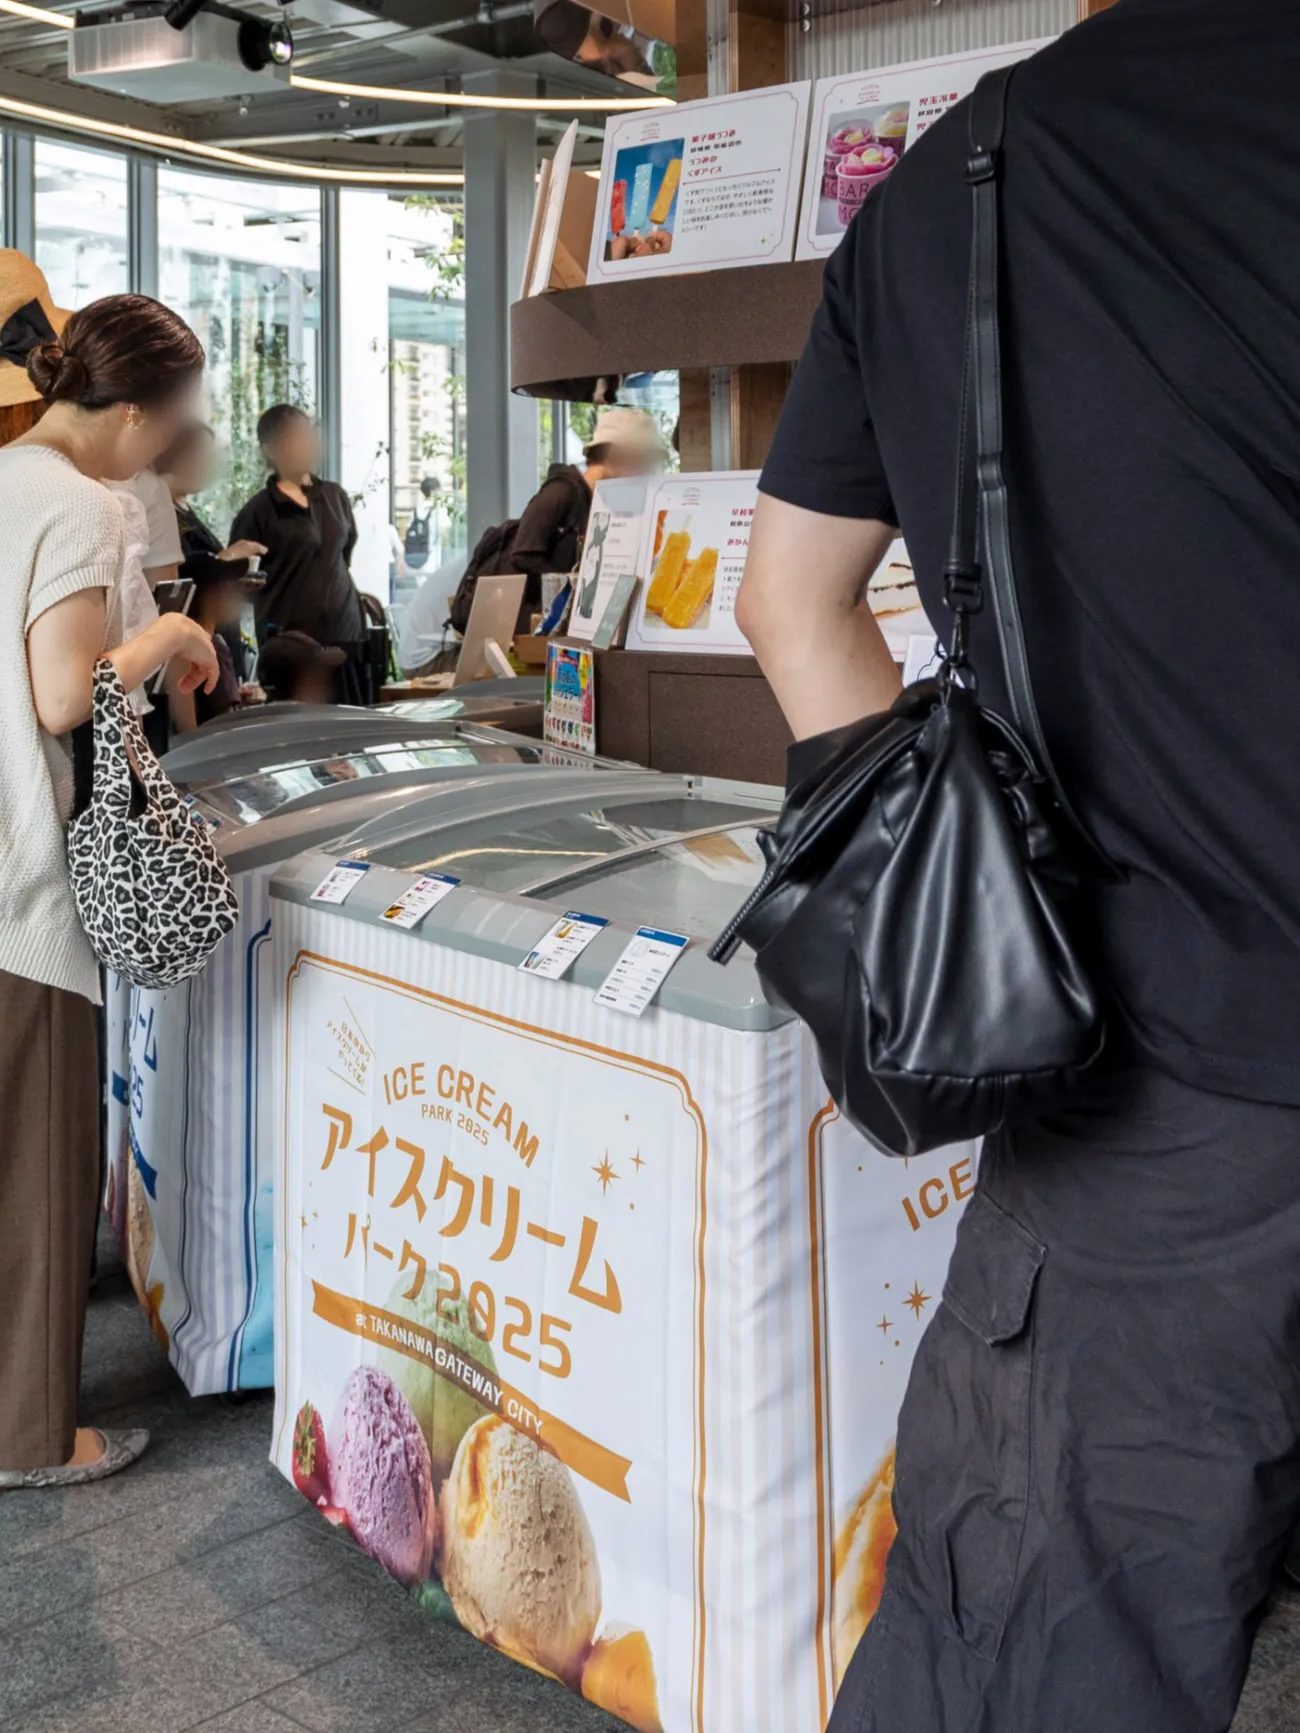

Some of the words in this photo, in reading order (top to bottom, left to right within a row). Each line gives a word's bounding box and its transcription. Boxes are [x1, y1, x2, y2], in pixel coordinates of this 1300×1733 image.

[840, 182, 869, 198] BAR
[383, 1062, 426, 1106] ICE
[437, 1064, 540, 1169] CREAM
[421, 1104, 453, 1123] PARK
[457, 1112, 490, 1146] 2025
[320, 1103, 623, 1314] アイスクリーム
[901, 1157, 976, 1232] ICE
[344, 1213, 573, 1379] パーク2025
[355, 1314, 368, 1330] at
[370, 1315, 434, 1360] TAKANAWA
[434, 1347, 504, 1406] GATEWAY
[507, 1399, 544, 1436] CITY
